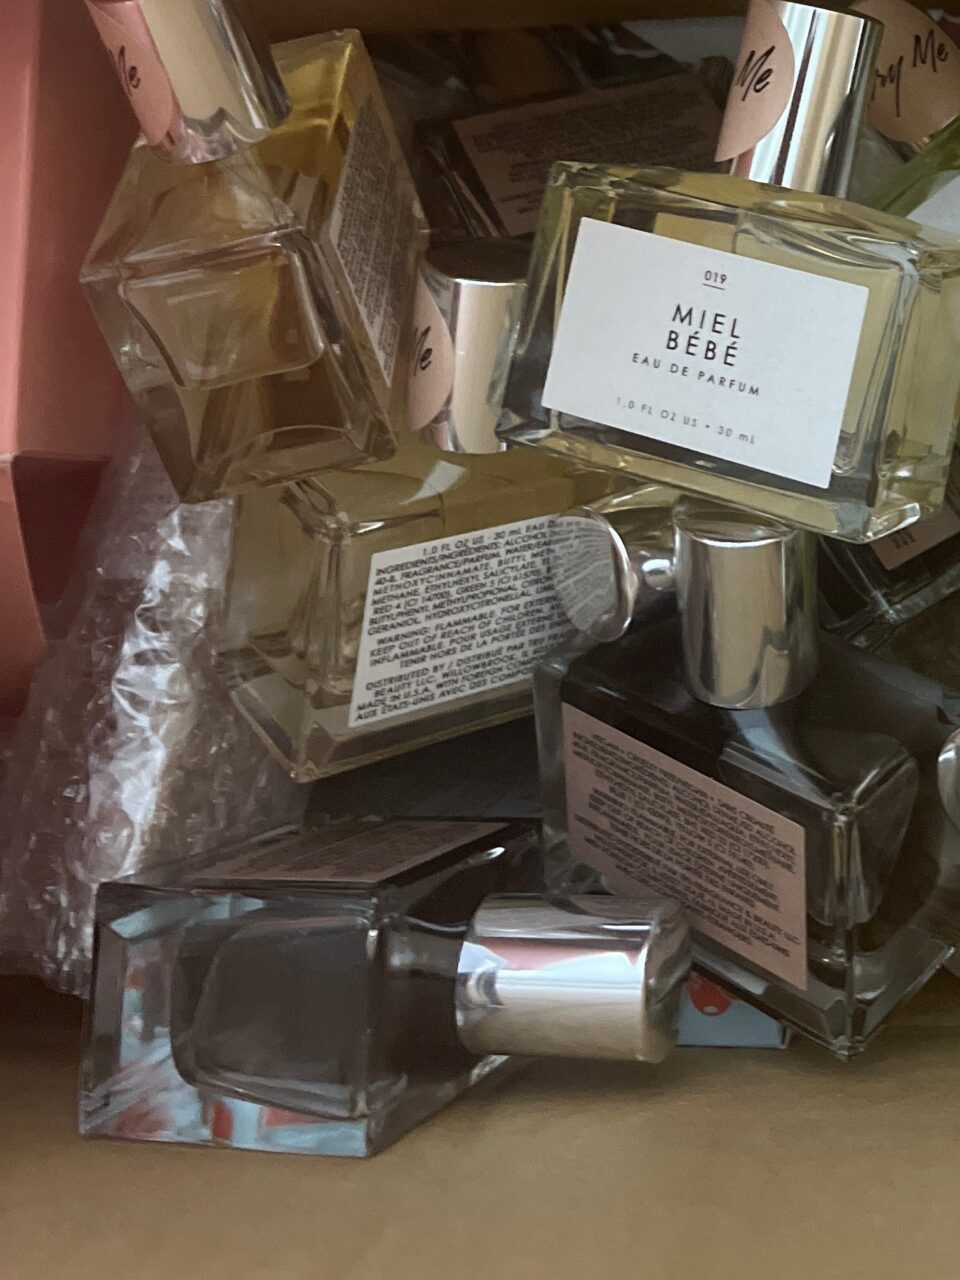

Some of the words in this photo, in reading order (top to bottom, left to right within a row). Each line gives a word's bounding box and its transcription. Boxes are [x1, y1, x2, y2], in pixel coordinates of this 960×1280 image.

[912, 28, 949, 73] Me
[737, 45, 775, 102] Me
[702, 269, 727, 285] 019
[670, 302, 743, 339] MIEL
[665, 324, 740, 367] BÉBÉ
[631, 351, 661, 369] EAU
[669, 362, 689, 377] DE
[696, 369, 761, 396] PARFUM
[640, 403, 653, 415] FL
[659, 408, 676, 422] OZ
[682, 415, 697, 428] US
[716, 424, 732, 437] 30
[440, 541, 451, 552] FL
[454, 537, 470, 549] OZ
[471, 533, 484, 545] US
[369, 643, 395, 658] KEEP
[398, 636, 421, 650] OUT
[422, 632, 437, 644] OF
[440, 622, 475, 639] REACH
[477, 618, 492, 630] OF
[429, 645, 457, 661] HORS
[459, 641, 473, 654] DE
[475, 637, 488, 649] LA
[448, 631, 477, 647] POUR
[365, 665, 431, 691] DISTRIBUTED
[431, 661, 445, 674] BY
[506, 640, 524, 654] PAR
[373, 680, 411, 698] BEAUTY
